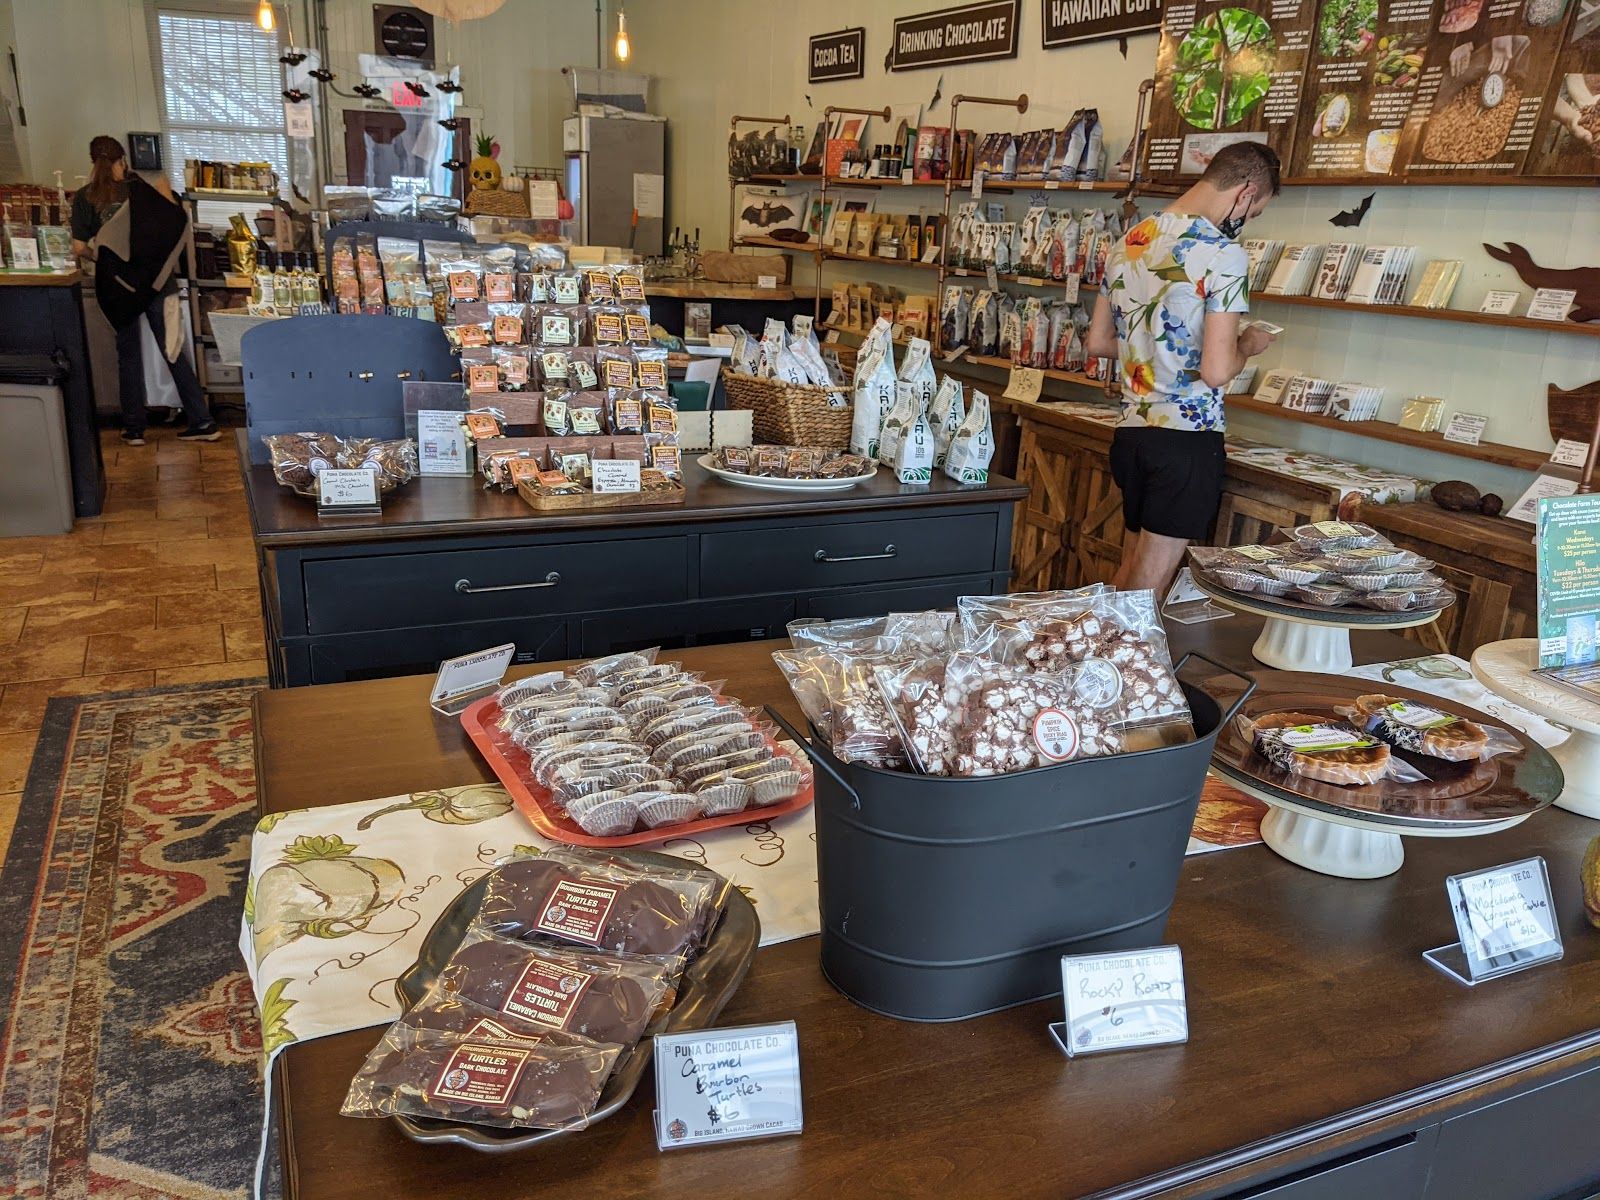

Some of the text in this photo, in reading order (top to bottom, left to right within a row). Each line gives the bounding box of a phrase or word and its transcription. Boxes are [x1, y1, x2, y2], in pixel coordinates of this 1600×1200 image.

[900, 17, 1006, 53] DRINKING CHOCOLATE
[814, 44, 856, 68] COCOA TEA
[1552, 501, 1577, 509] Chocolate
[1575, 559, 1586, 567] Hilo
[560, 883, 612, 899] BOURBON CARAMEL
[565, 893, 599, 908] TURTLES
[558, 901, 599, 915] DARK CHOCOLATE
[525, 982, 554, 997] CHOCOLATE
[524, 992, 560, 1012] TURTLES
[509, 1001, 565, 1025] BOURBON CARAMEL
[480, 1021, 508, 1040] BOURBON
[461, 1045, 525, 1058] BOURBON CARAMEL
[674, 1043, 701, 1058] PUNA
[705, 1038, 762, 1055] CHOCOLATE
[459, 1062, 508, 1075] DARK CHOCOLATE
[467, 1053, 508, 1066] TURTLES
[681, 1054, 742, 1078] Caramel
[695, 1074, 750, 1095] Bourbon
[708, 1082, 763, 1105] Turtles
[707, 1105, 740, 1126] $6
